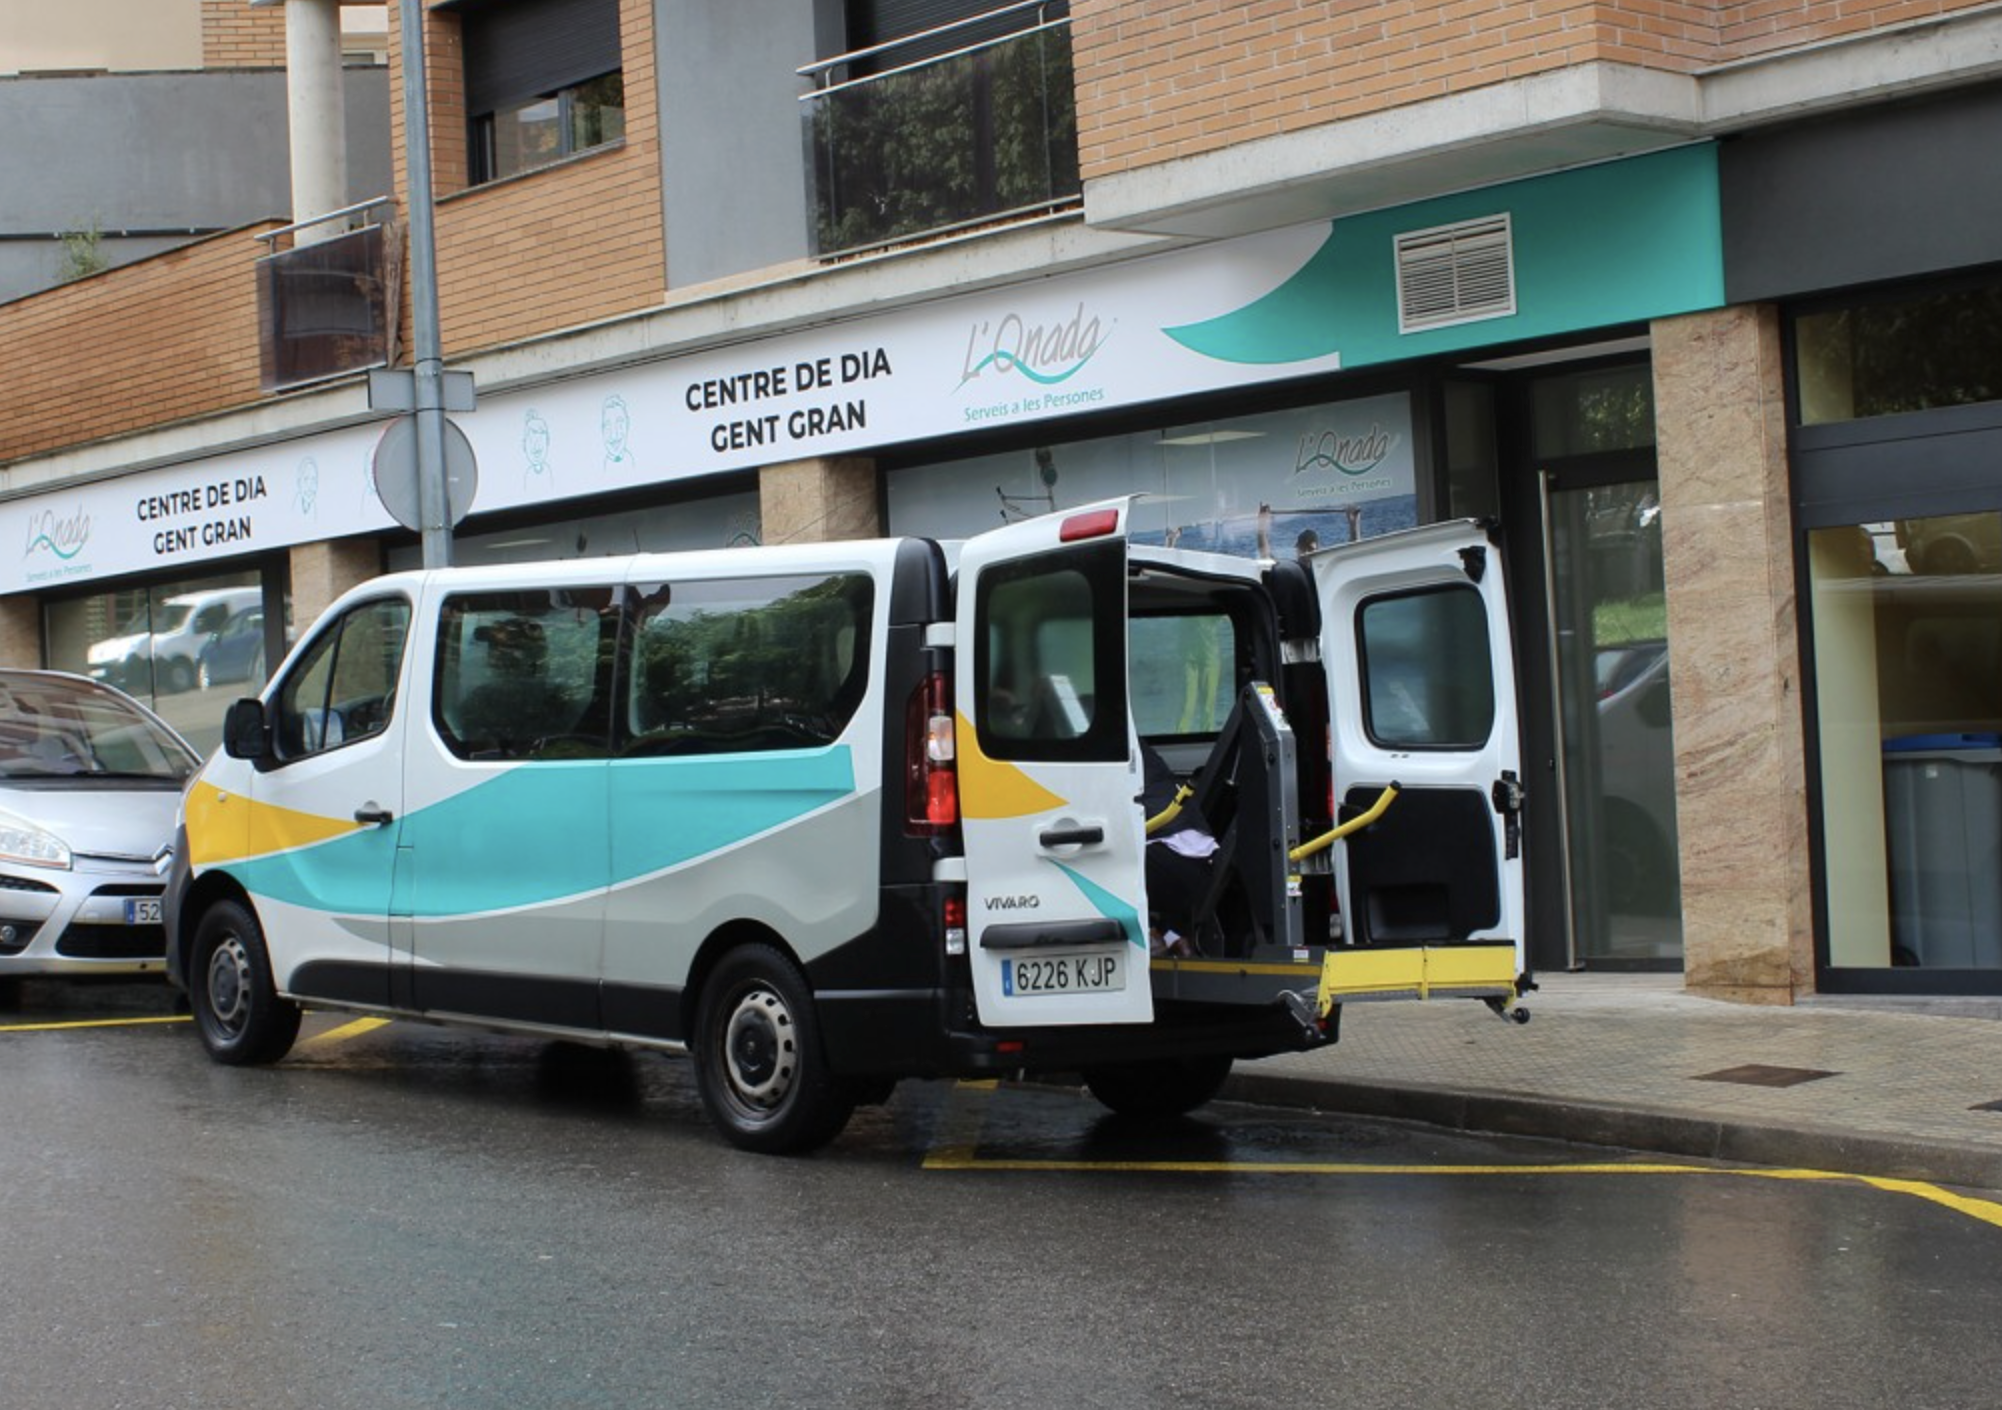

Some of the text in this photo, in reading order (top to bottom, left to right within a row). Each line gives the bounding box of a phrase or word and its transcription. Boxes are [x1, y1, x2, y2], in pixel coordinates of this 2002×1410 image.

[685, 347, 892, 411] CENTRE DE DIA
[964, 387, 1105, 422] Serveis a les Persones
[711, 399, 867, 453] GENT GRAN
[137, 475, 267, 521] CENTRE DE DIA
[153, 515, 251, 555] GENT GRAN
[984, 895, 1040, 911] VIVARO
[1017, 957, 1116, 991] 6226 KJP
